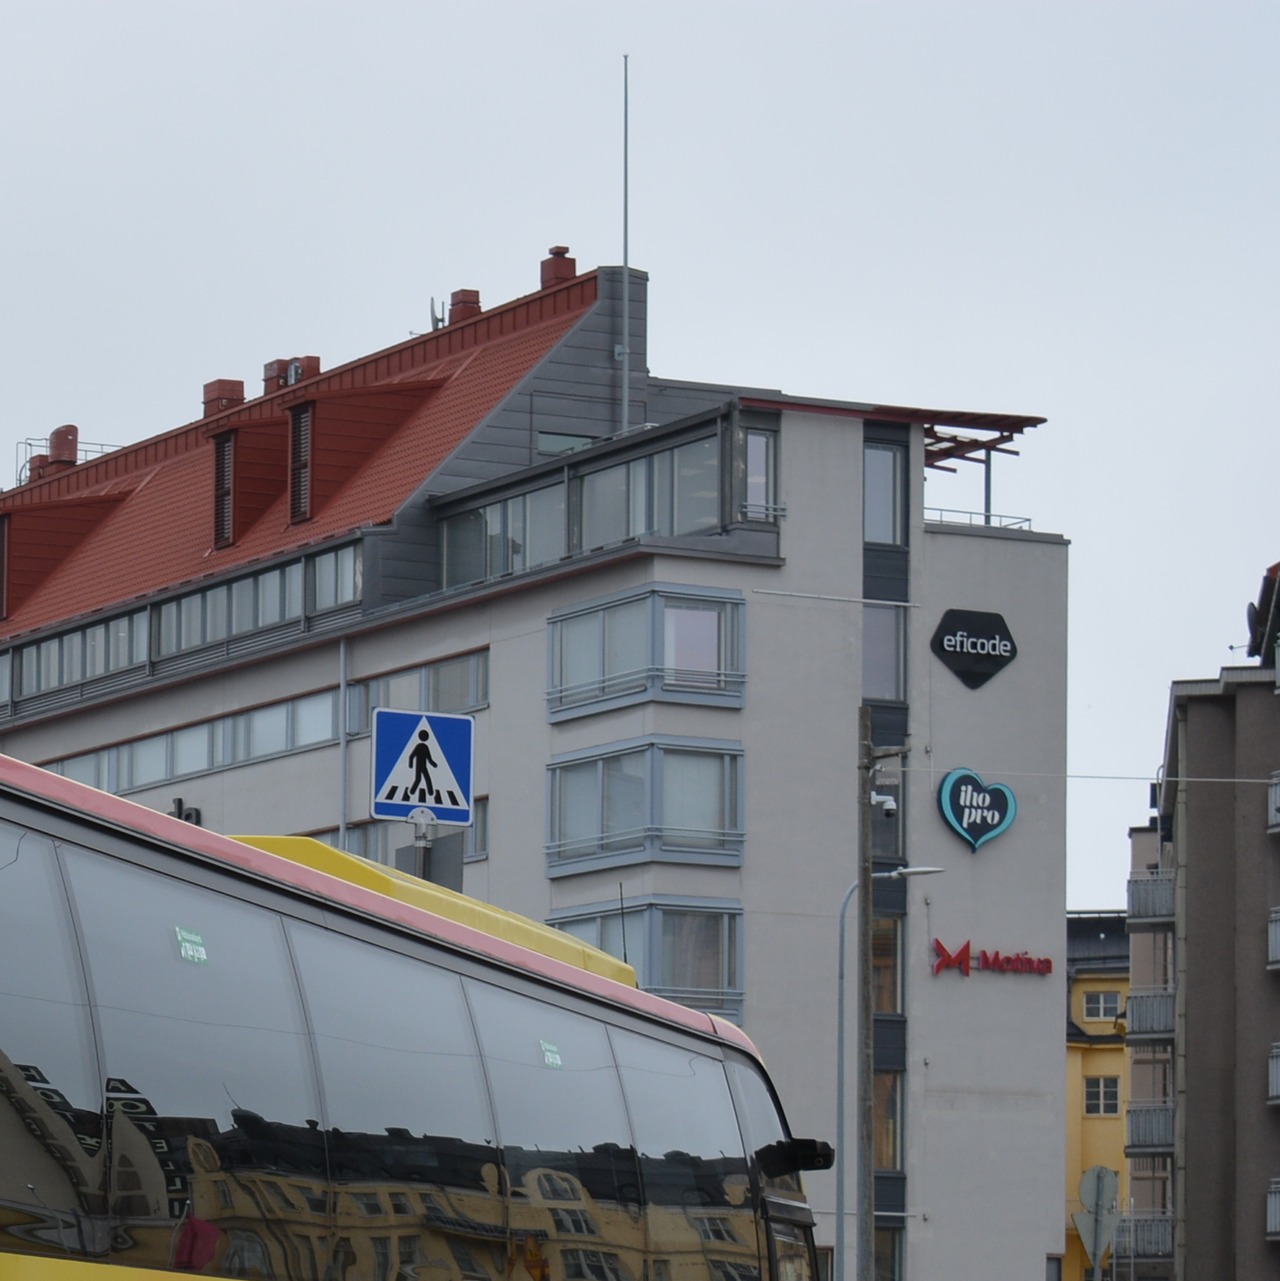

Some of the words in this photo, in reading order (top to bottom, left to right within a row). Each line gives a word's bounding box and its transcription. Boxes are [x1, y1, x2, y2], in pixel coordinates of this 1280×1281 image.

[942, 631, 1012, 657] eficode
[959, 784, 991, 808] iho
[962, 807, 1000, 829] pro
[979, 950, 1052, 974] Motiva
